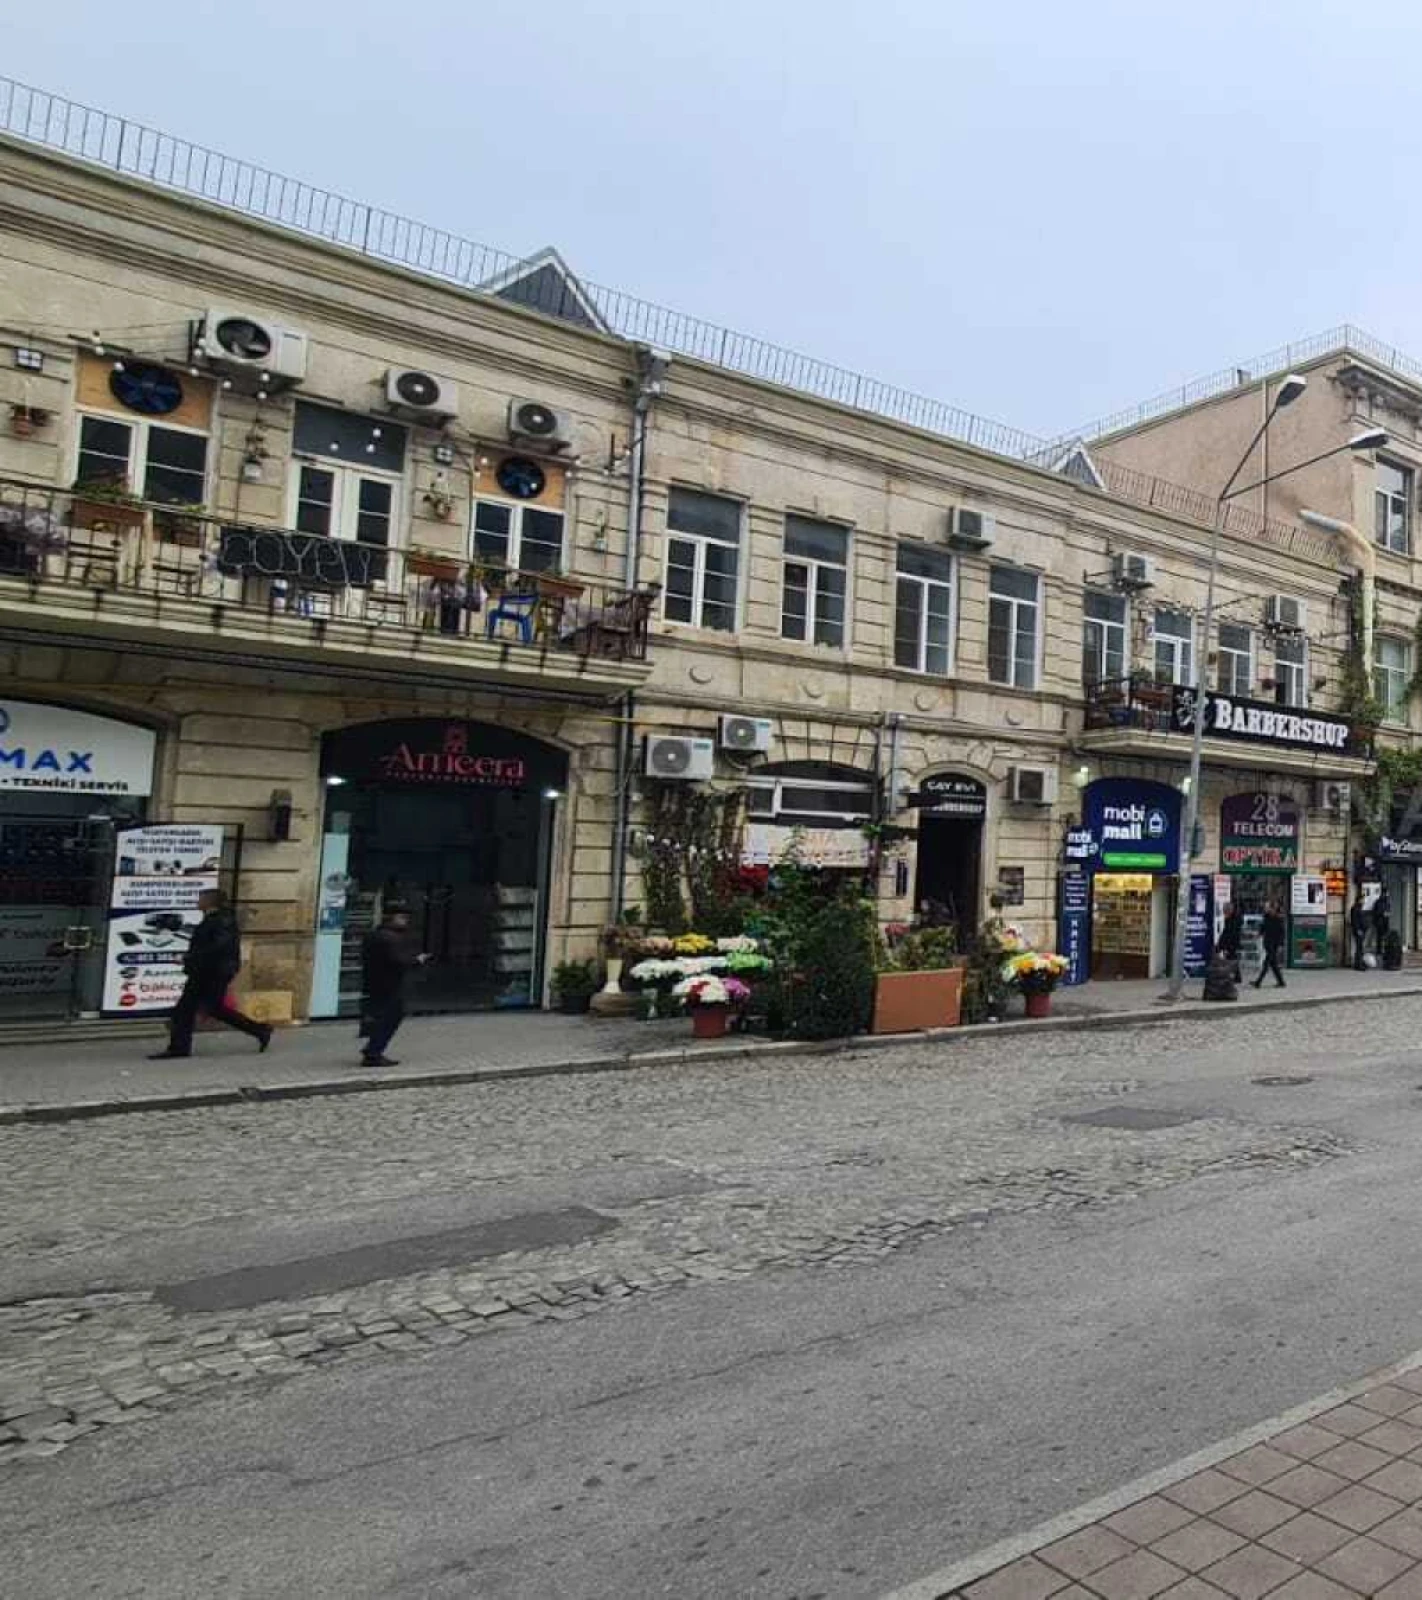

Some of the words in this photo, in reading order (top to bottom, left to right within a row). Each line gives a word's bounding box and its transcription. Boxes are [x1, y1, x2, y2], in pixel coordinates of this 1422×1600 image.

[1215, 699, 1349, 747] BARBERSHOP
[1103, 804, 1145, 821] mobi
[1251, 794, 1279, 820] 28
[1102, 823, 1142, 840] mall
[1233, 822, 1294, 837] TELECOM
